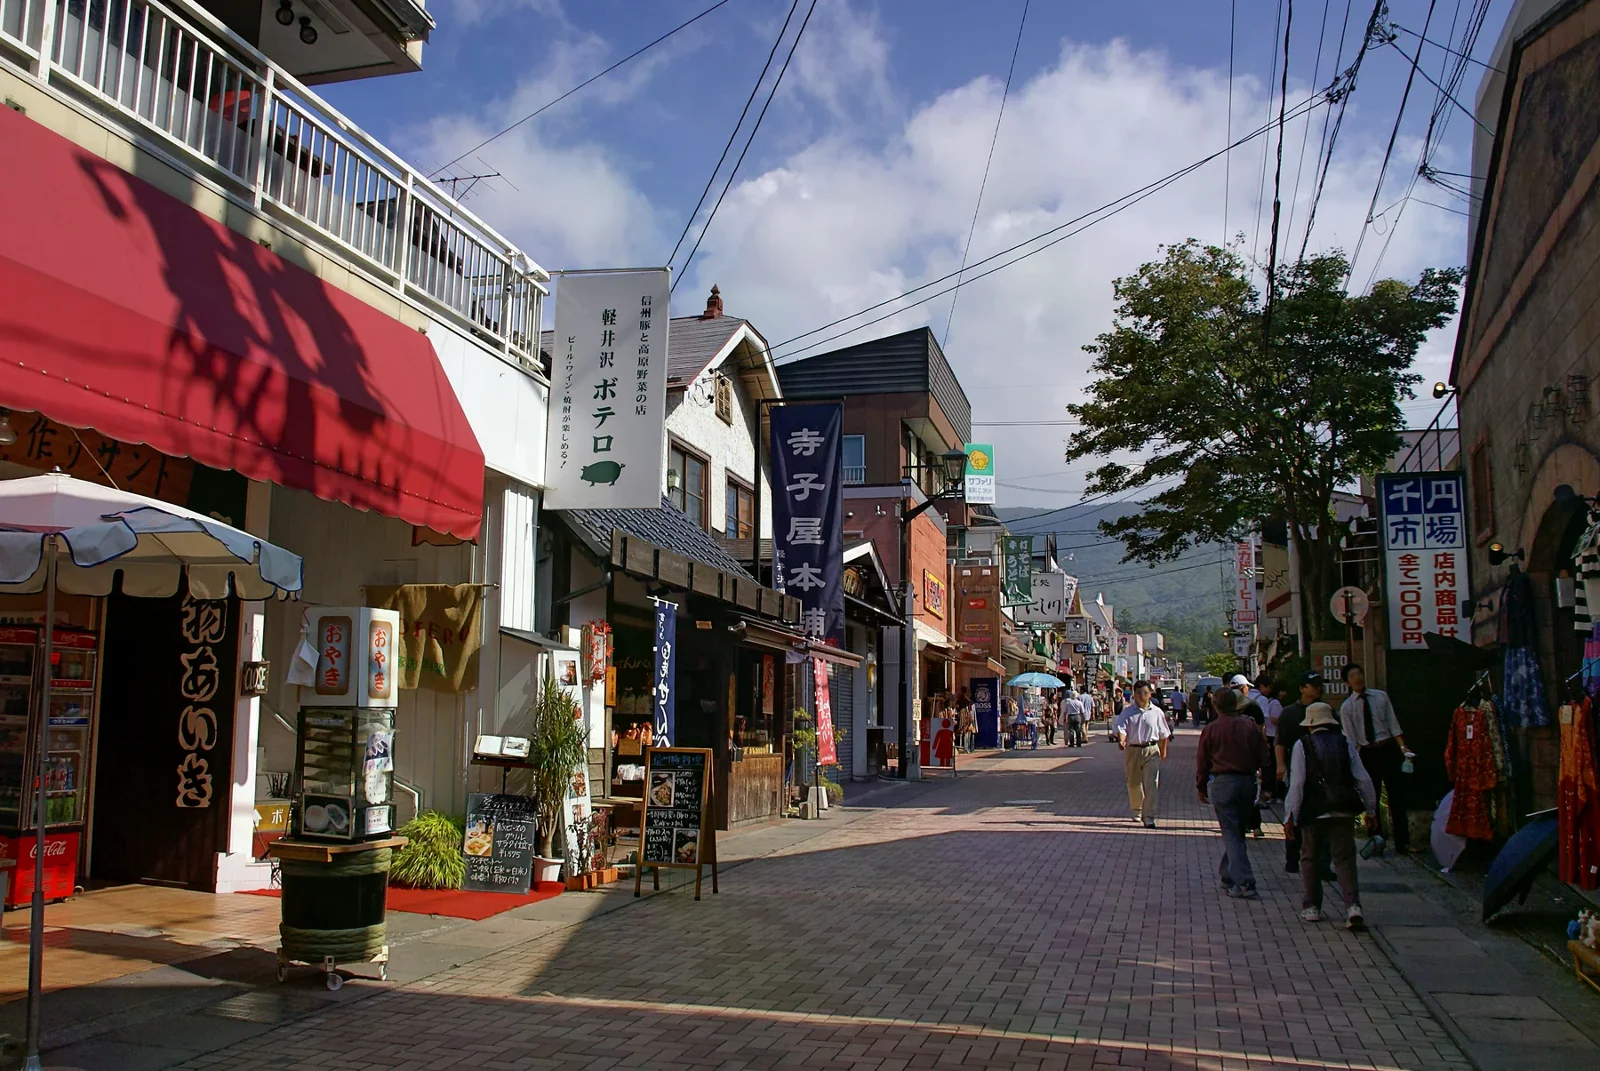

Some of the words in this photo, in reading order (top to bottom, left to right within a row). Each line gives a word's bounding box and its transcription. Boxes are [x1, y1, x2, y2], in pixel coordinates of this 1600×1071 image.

[599, 308, 617, 369] 軽井沢
[635, 295, 652, 416] 信州豚と高原野菜の店
[592, 377, 618, 454] ボテロ
[1238, 542, 1252, 609] ミカドーヒー
[244, 665, 267, 691] CLOSE
[324, 623, 343, 688] おやき
[373, 627, 387, 692] おやき
